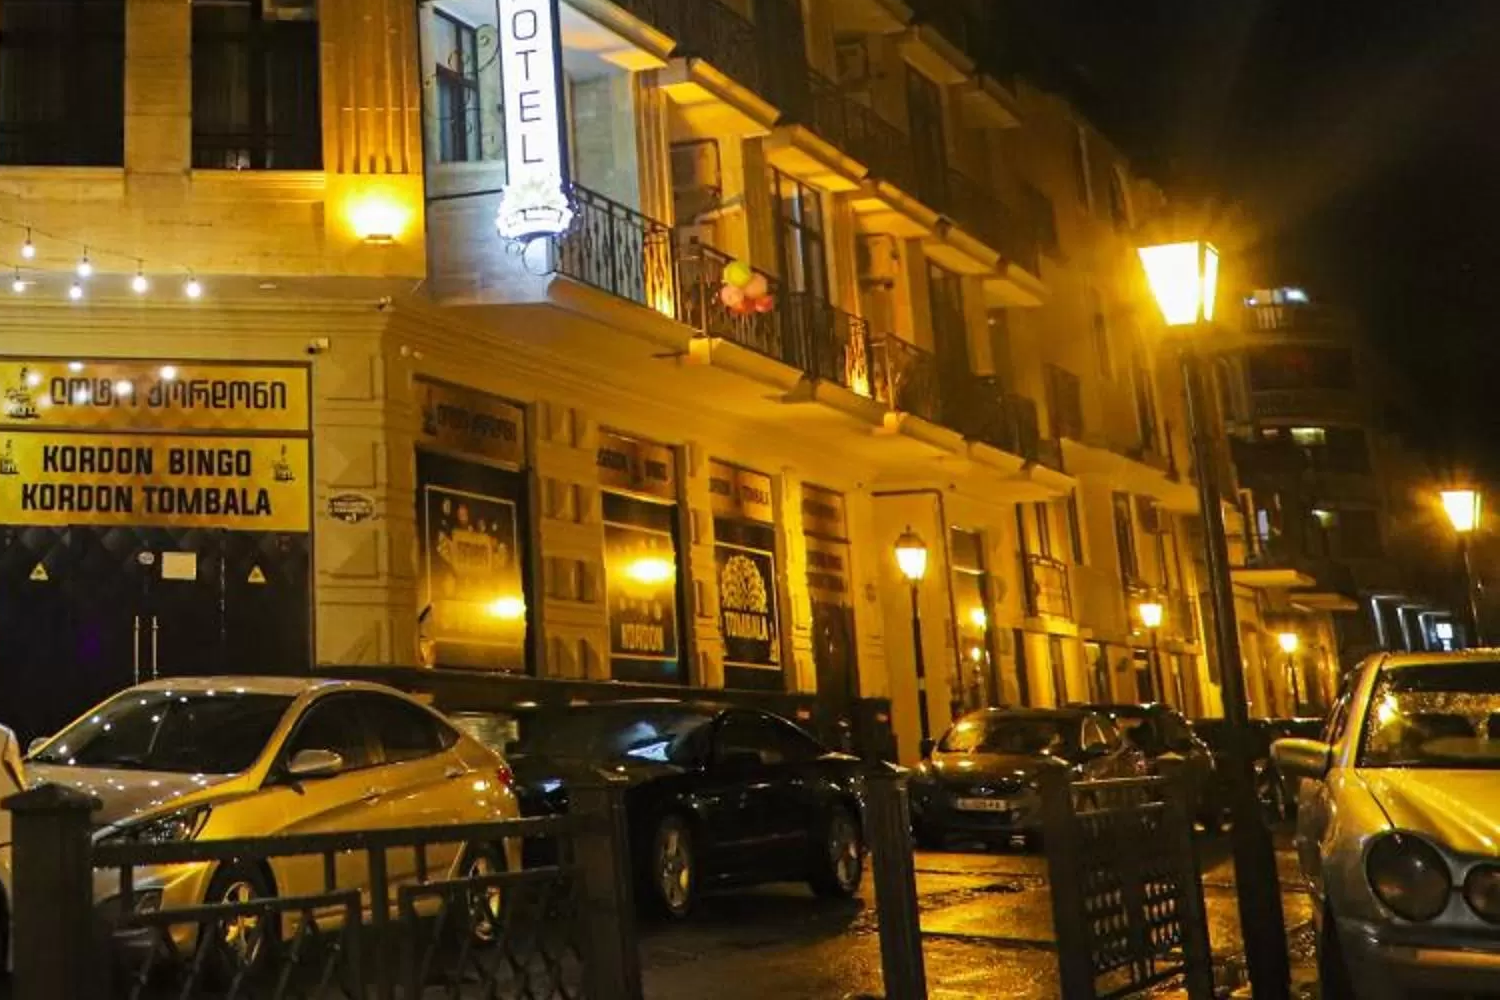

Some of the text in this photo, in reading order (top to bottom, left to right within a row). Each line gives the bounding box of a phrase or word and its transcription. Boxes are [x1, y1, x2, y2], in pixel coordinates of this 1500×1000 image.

[42, 445, 253, 477] KORDON BINGO
[21, 483, 272, 516] KORDON TOMBALA
